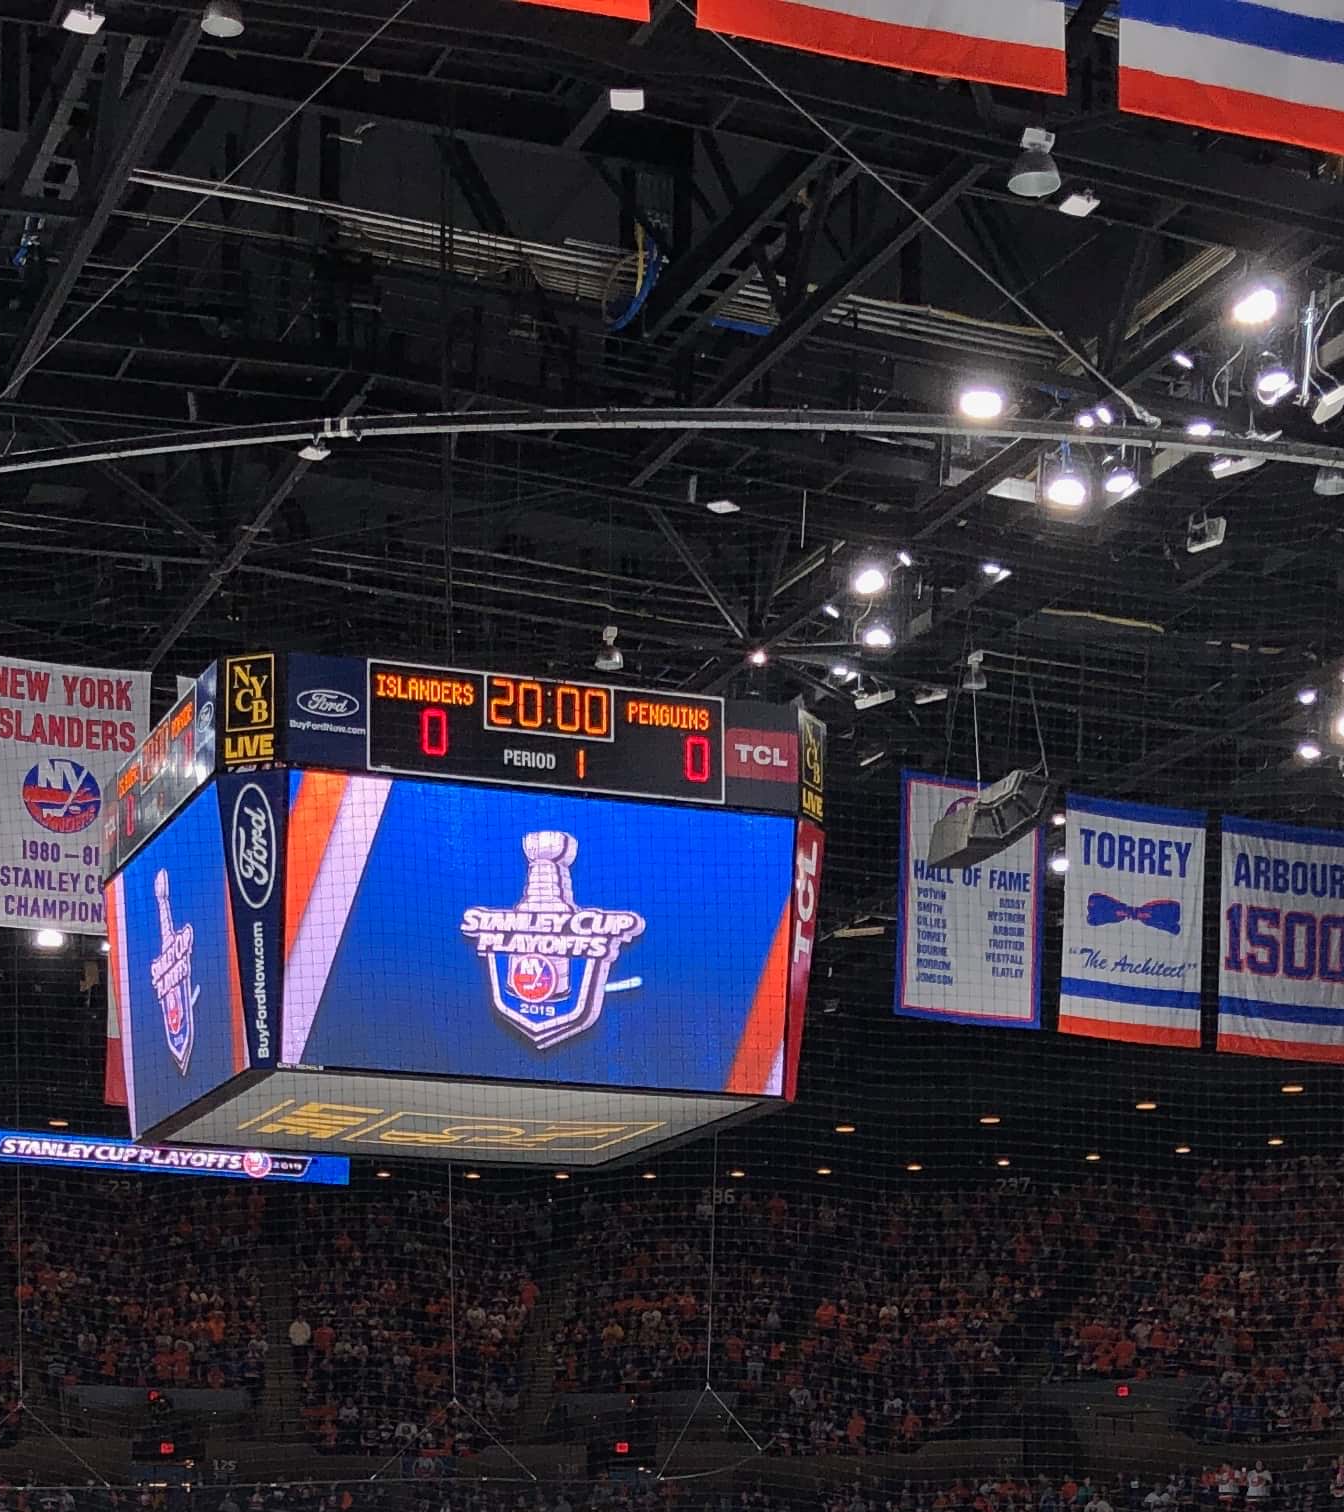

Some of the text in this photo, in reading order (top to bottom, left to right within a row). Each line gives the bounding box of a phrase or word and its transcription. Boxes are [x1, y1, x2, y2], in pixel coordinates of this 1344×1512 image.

[62, 674, 132, 712] YORK
[307, 693, 348, 713] Ford
[376, 674, 475, 705] ISLANDERS
[490, 680, 609, 736] 20:00
[627, 701, 711, 732] PENGUINS
[289, 719, 367, 736] BuyFordNow.com
[420, 708, 449, 758] 0
[225, 733, 274, 759] LIVE
[503, 749, 557, 770] PERIOD
[684, 735, 712, 784] 0
[735, 743, 789, 768] TCL
[577, 749, 586, 780] 1
[803, 787, 824, 818] LIVE
[22, 839, 60, 863] 1980
[241, 803, 269, 886] Ford
[1079, 827, 1193, 879] TORREY
[0, 866, 105, 895] STANLEY CU
[962, 865, 982, 888] OF
[989, 869, 1031, 892] FAME
[4, 895, 106, 922] CHAMPION
[793, 840, 818, 964] TCL
[460, 909, 634, 935] STANLEY CUP
[478, 933, 609, 957] PLAYOFFS
[254, 921, 270, 1059] BuyFordNow.com
[519, 1003, 556, 1017] 2019
[3, 1139, 96, 1157] STANLEY
[95, 1144, 140, 1161] CUP
[138, 1147, 242, 1170] PLAYOFFS
